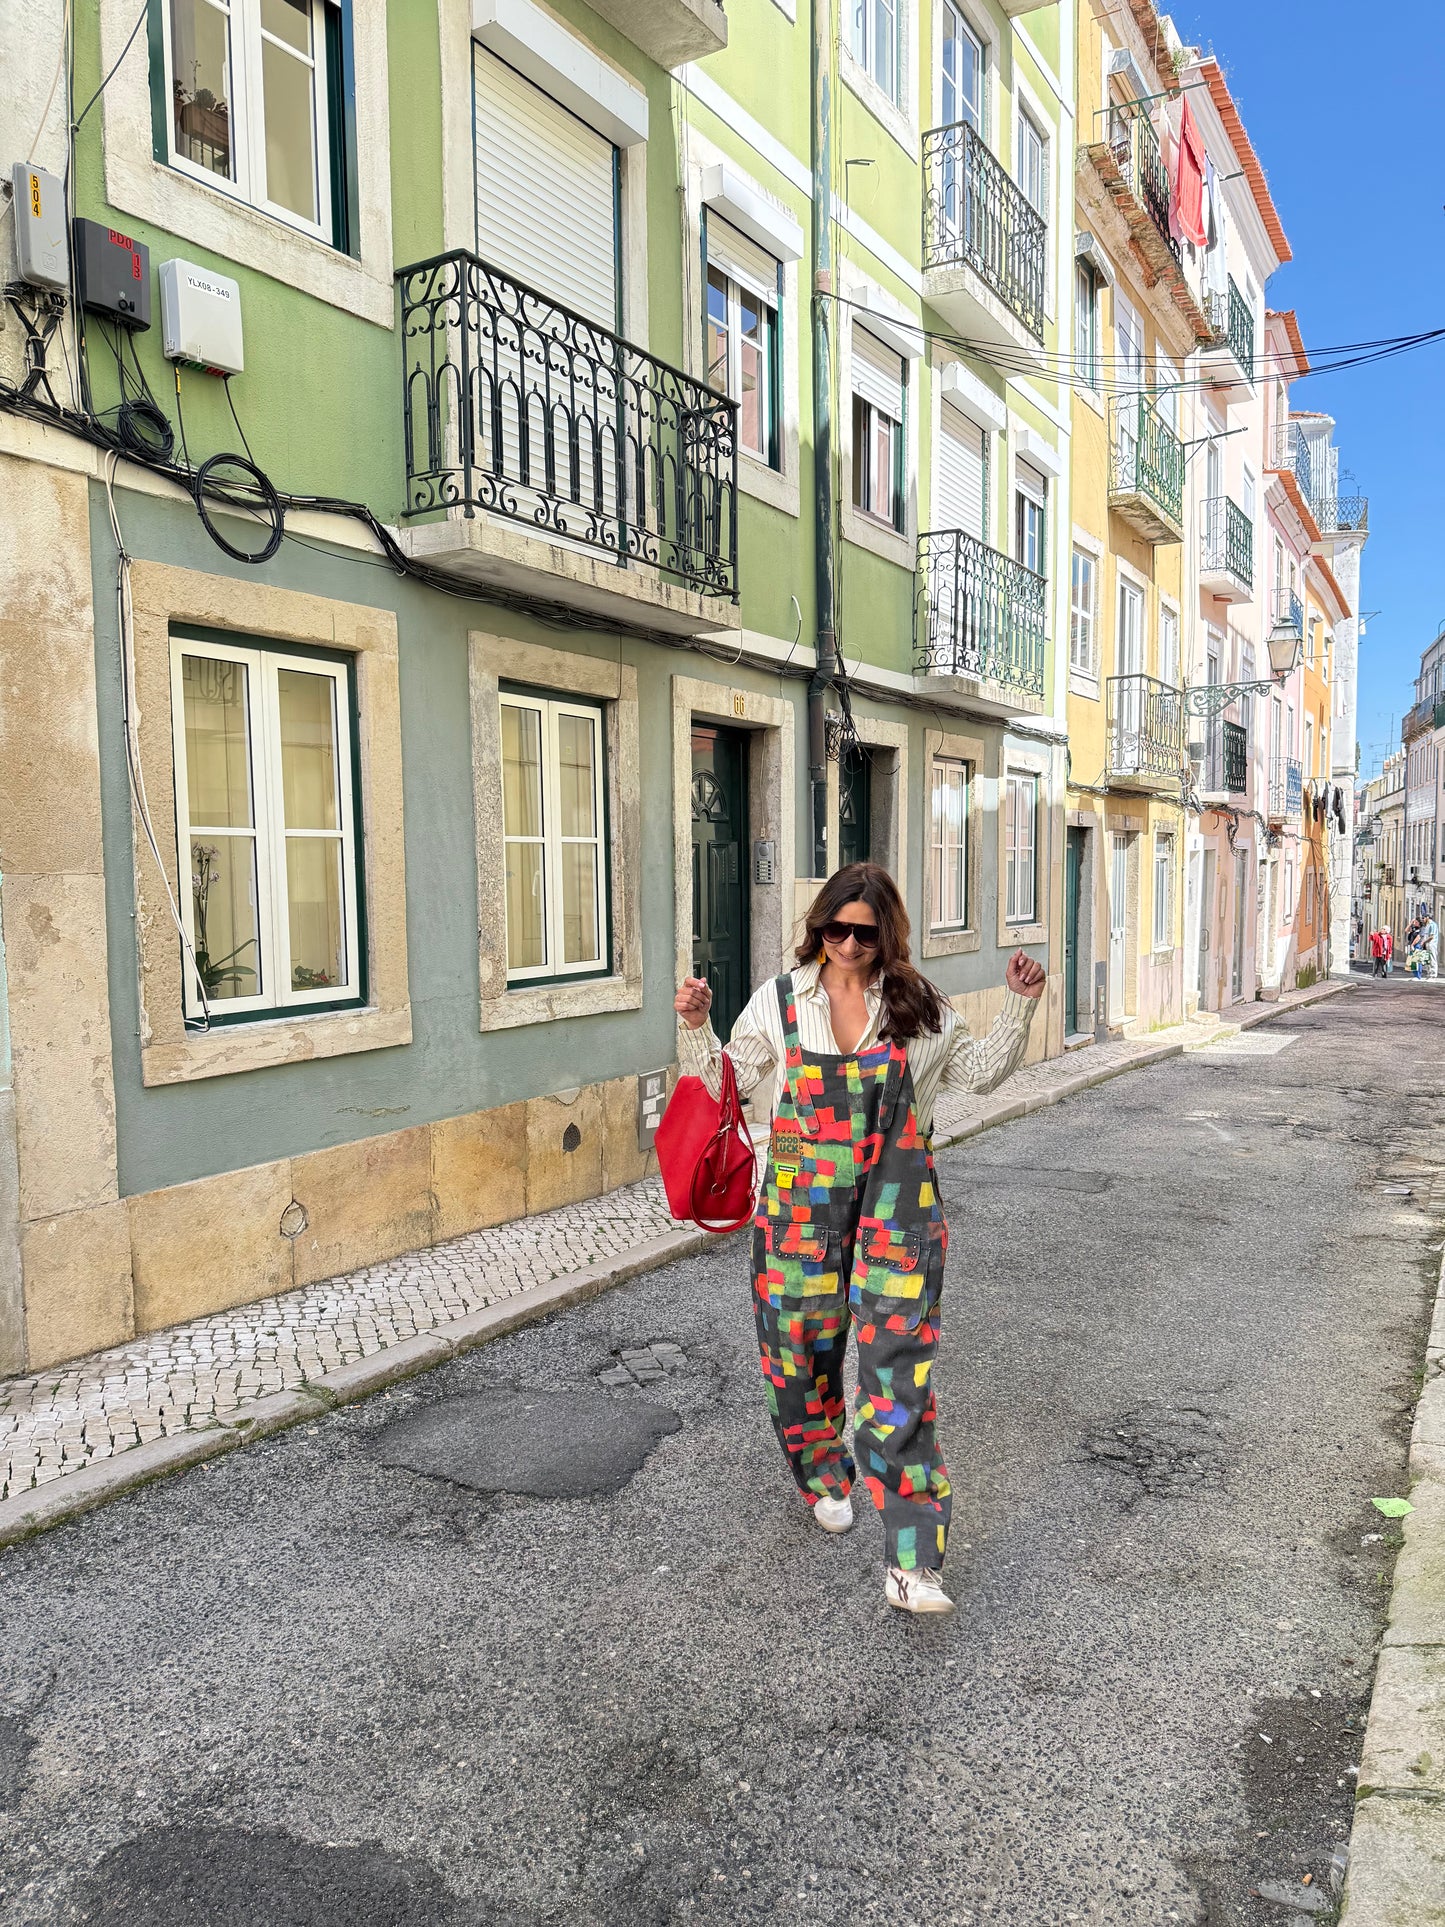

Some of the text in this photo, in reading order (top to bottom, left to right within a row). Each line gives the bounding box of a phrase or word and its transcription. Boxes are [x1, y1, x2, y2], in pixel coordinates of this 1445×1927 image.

[31, 175, 40, 217] 504
[187, 276, 230, 299] YLX08-349
[734, 694, 746, 716] 66
[776, 1143, 799, 1154] LUCK
